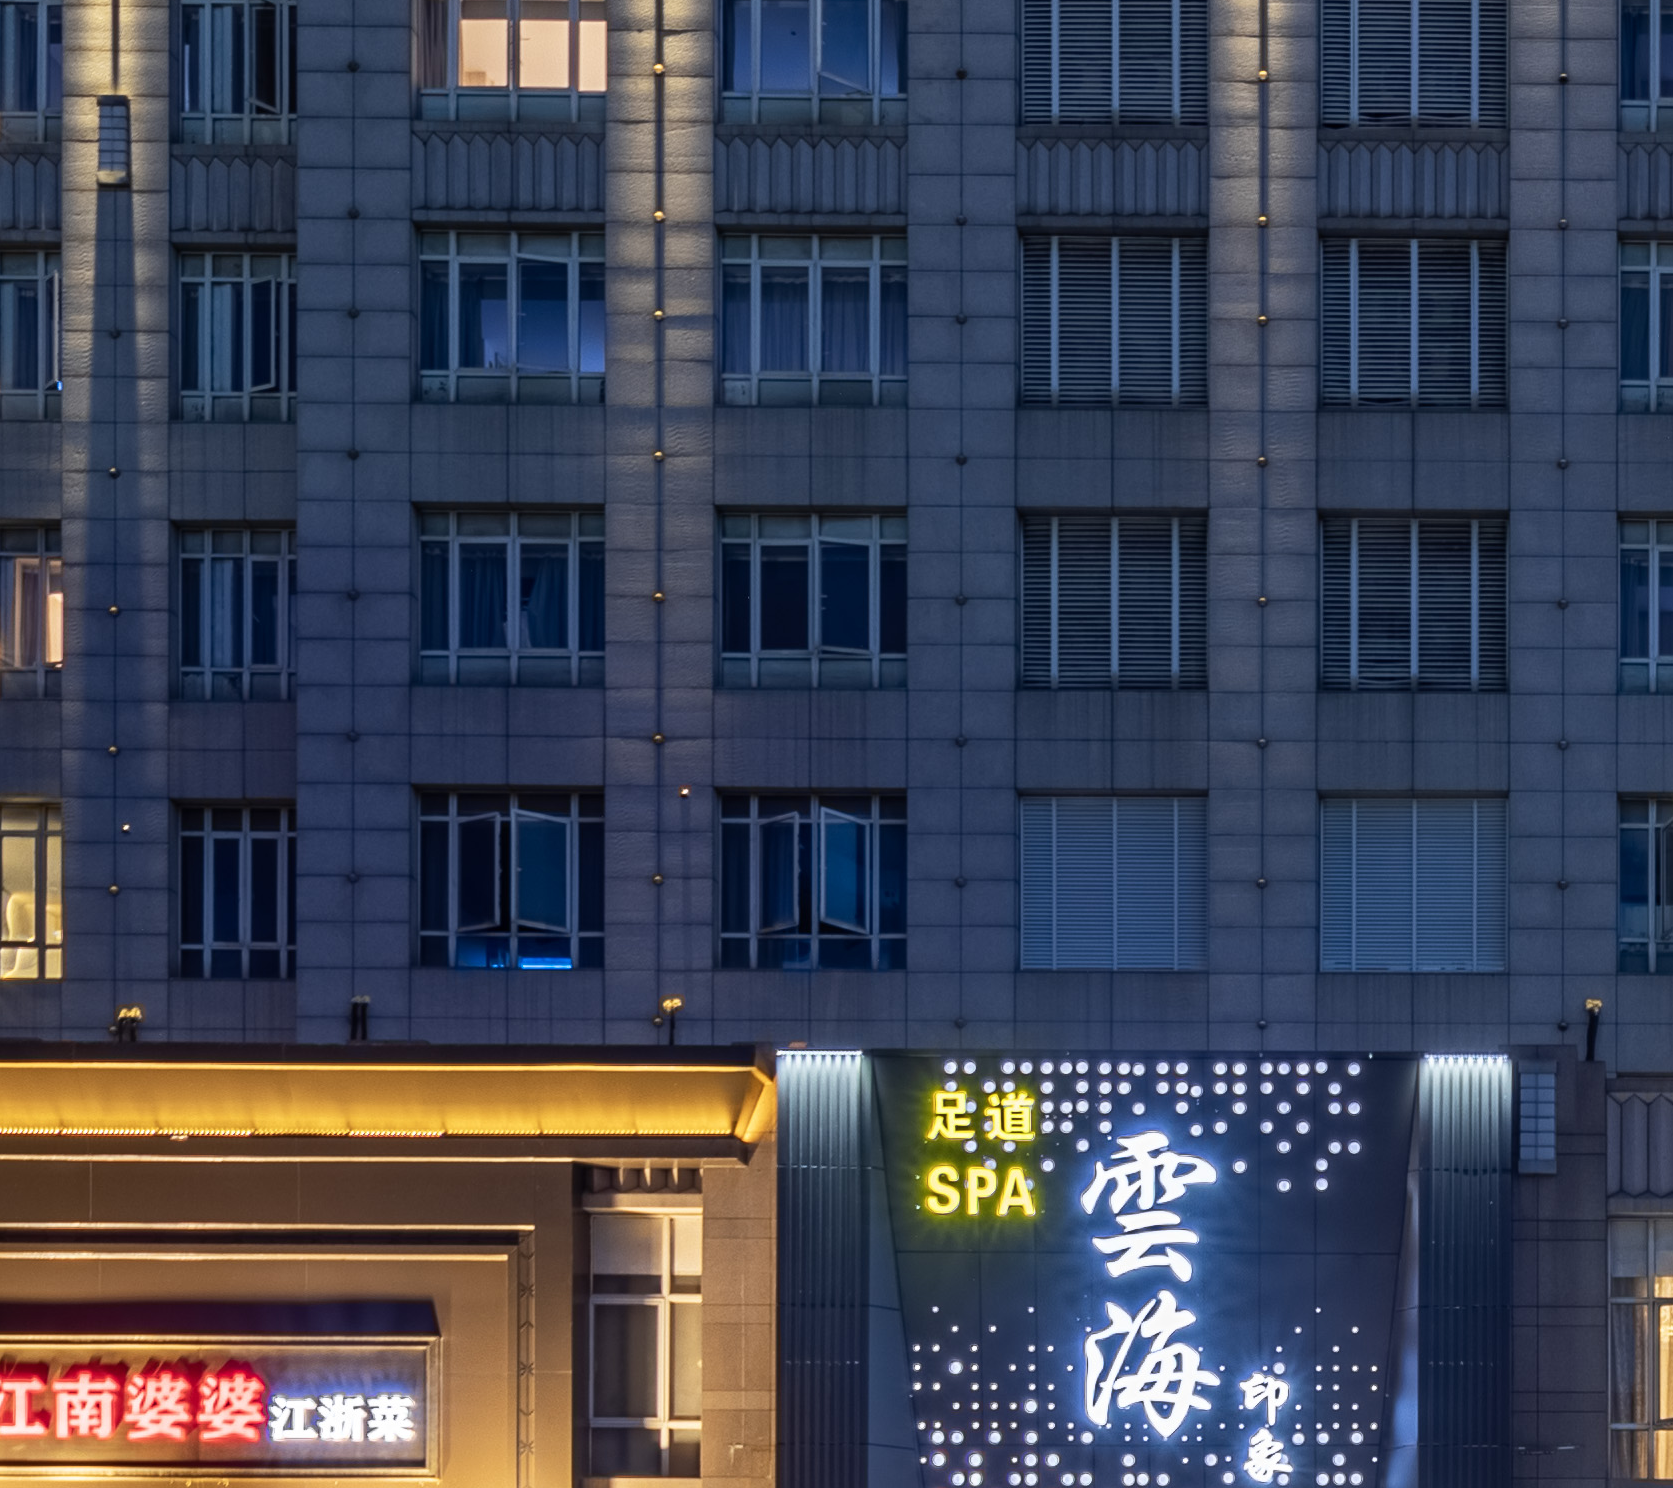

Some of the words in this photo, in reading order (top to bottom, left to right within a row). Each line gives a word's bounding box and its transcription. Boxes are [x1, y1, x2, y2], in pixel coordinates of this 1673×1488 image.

[927, 1090, 1036, 1142] 足道
[926, 1165, 1036, 1217] SPA
[269, 1394, 416, 1443] 江浙菜
[1240, 1371, 1294, 1484] 印象
